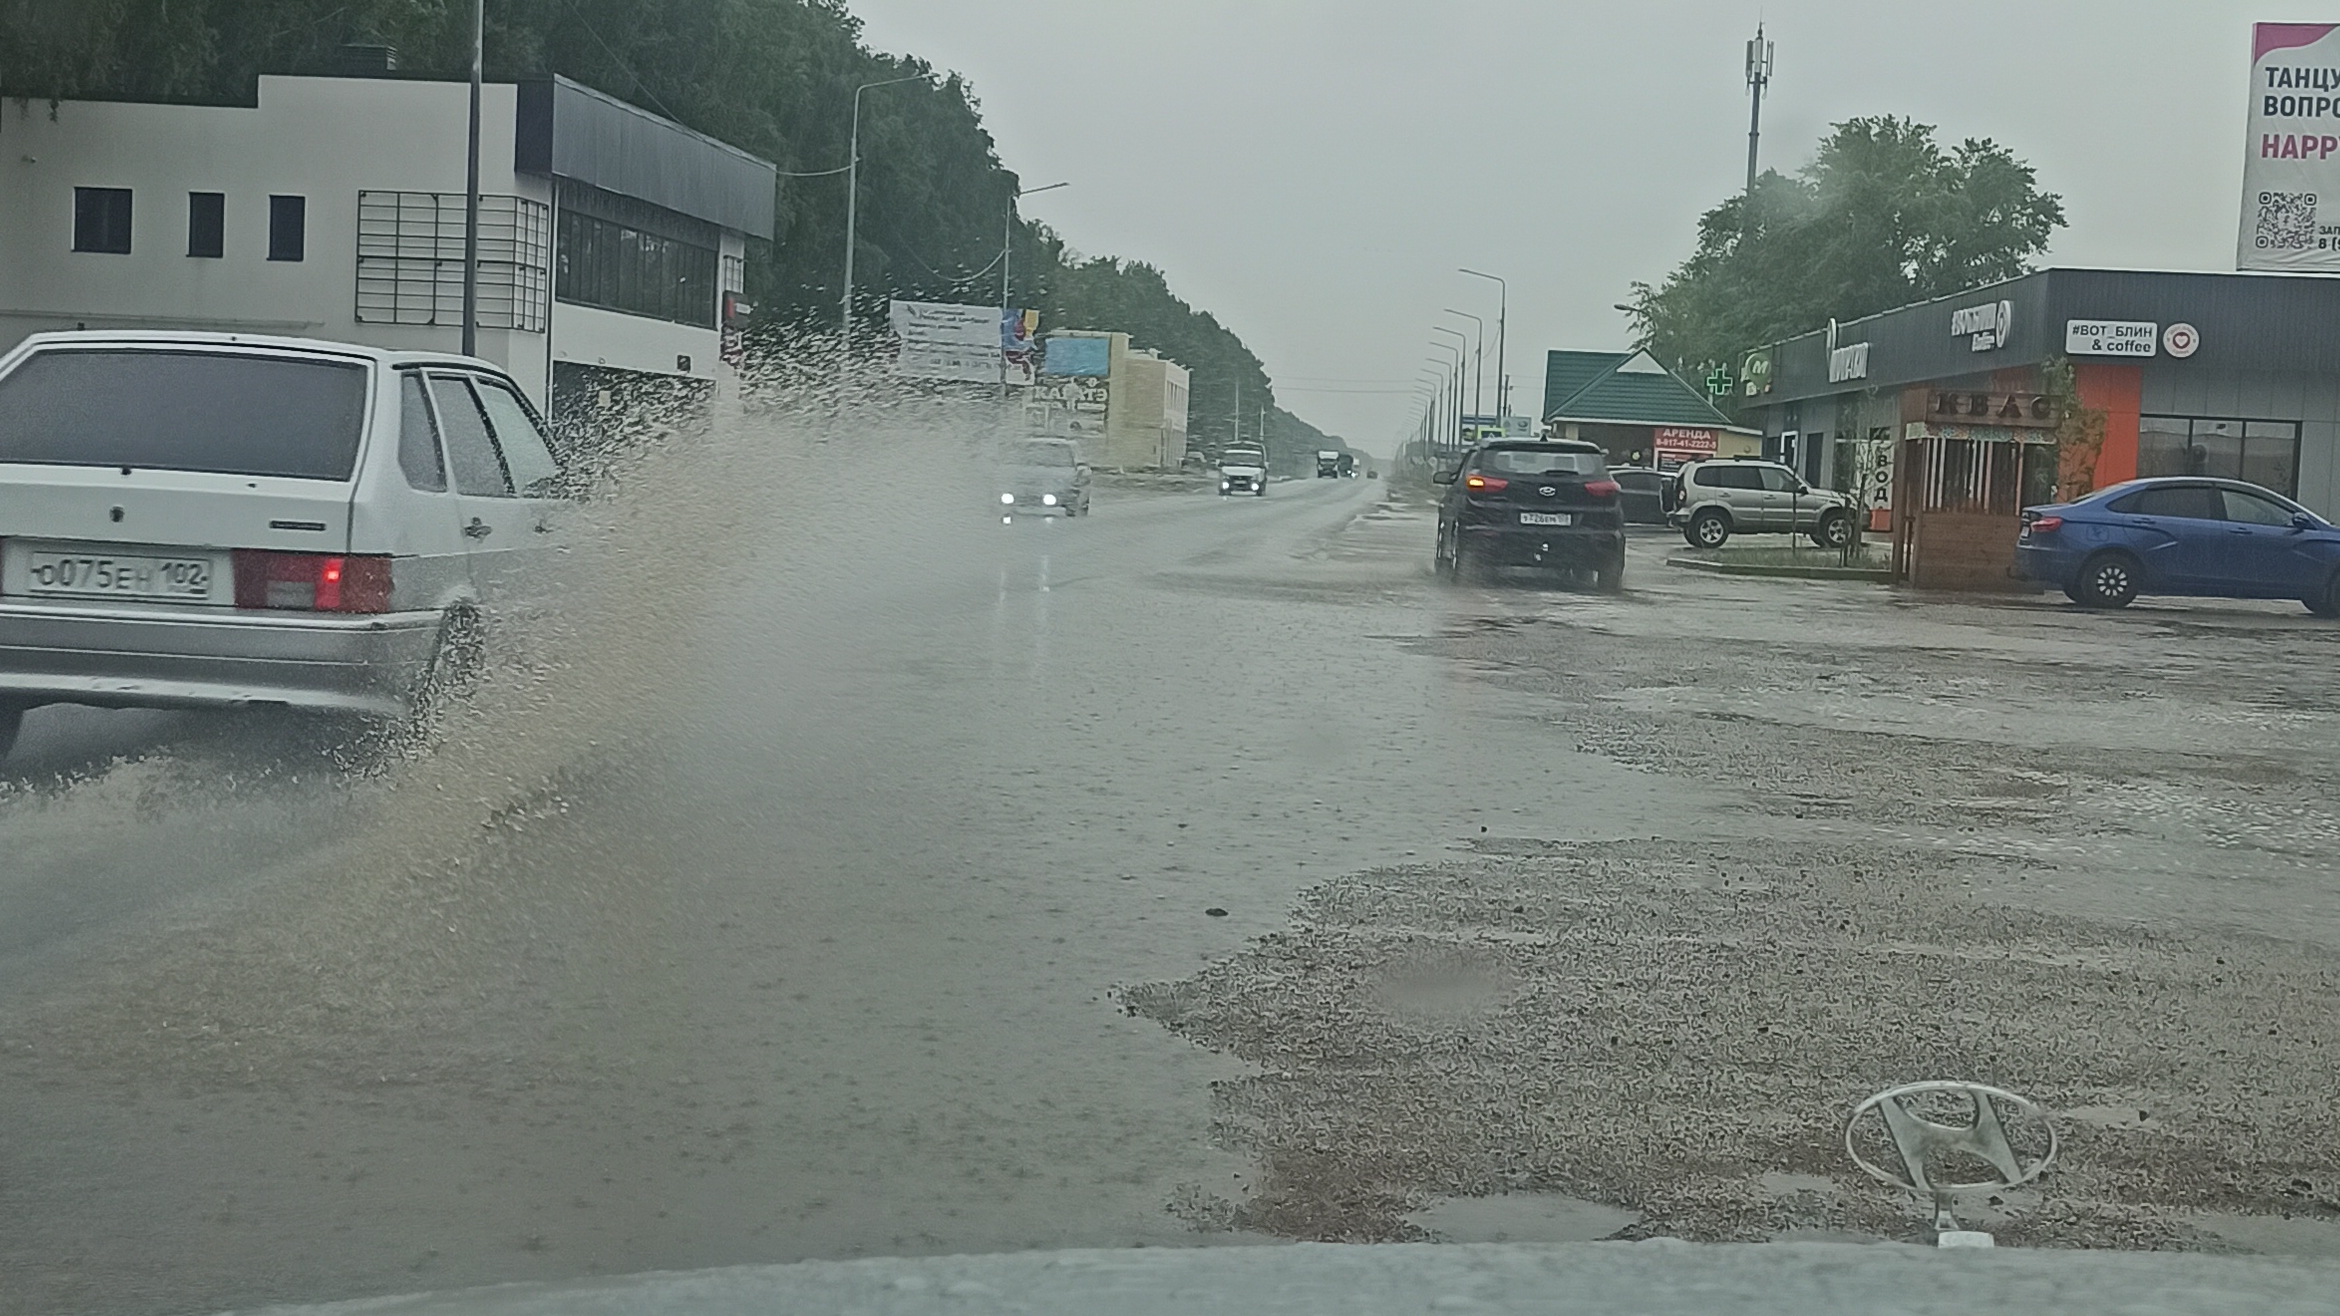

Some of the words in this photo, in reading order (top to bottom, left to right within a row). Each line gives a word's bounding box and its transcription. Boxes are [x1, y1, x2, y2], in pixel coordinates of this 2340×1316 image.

[2261, 133, 2340, 160] HAPP
[2072, 324, 2152, 339] #ВОТ_БЛИН
[2091, 338, 2102, 351] &
[2106, 339, 2151, 353] coffee
[1935, 392, 2051, 420] КВАС
[1662, 428, 1711, 440] АРЕНДА
